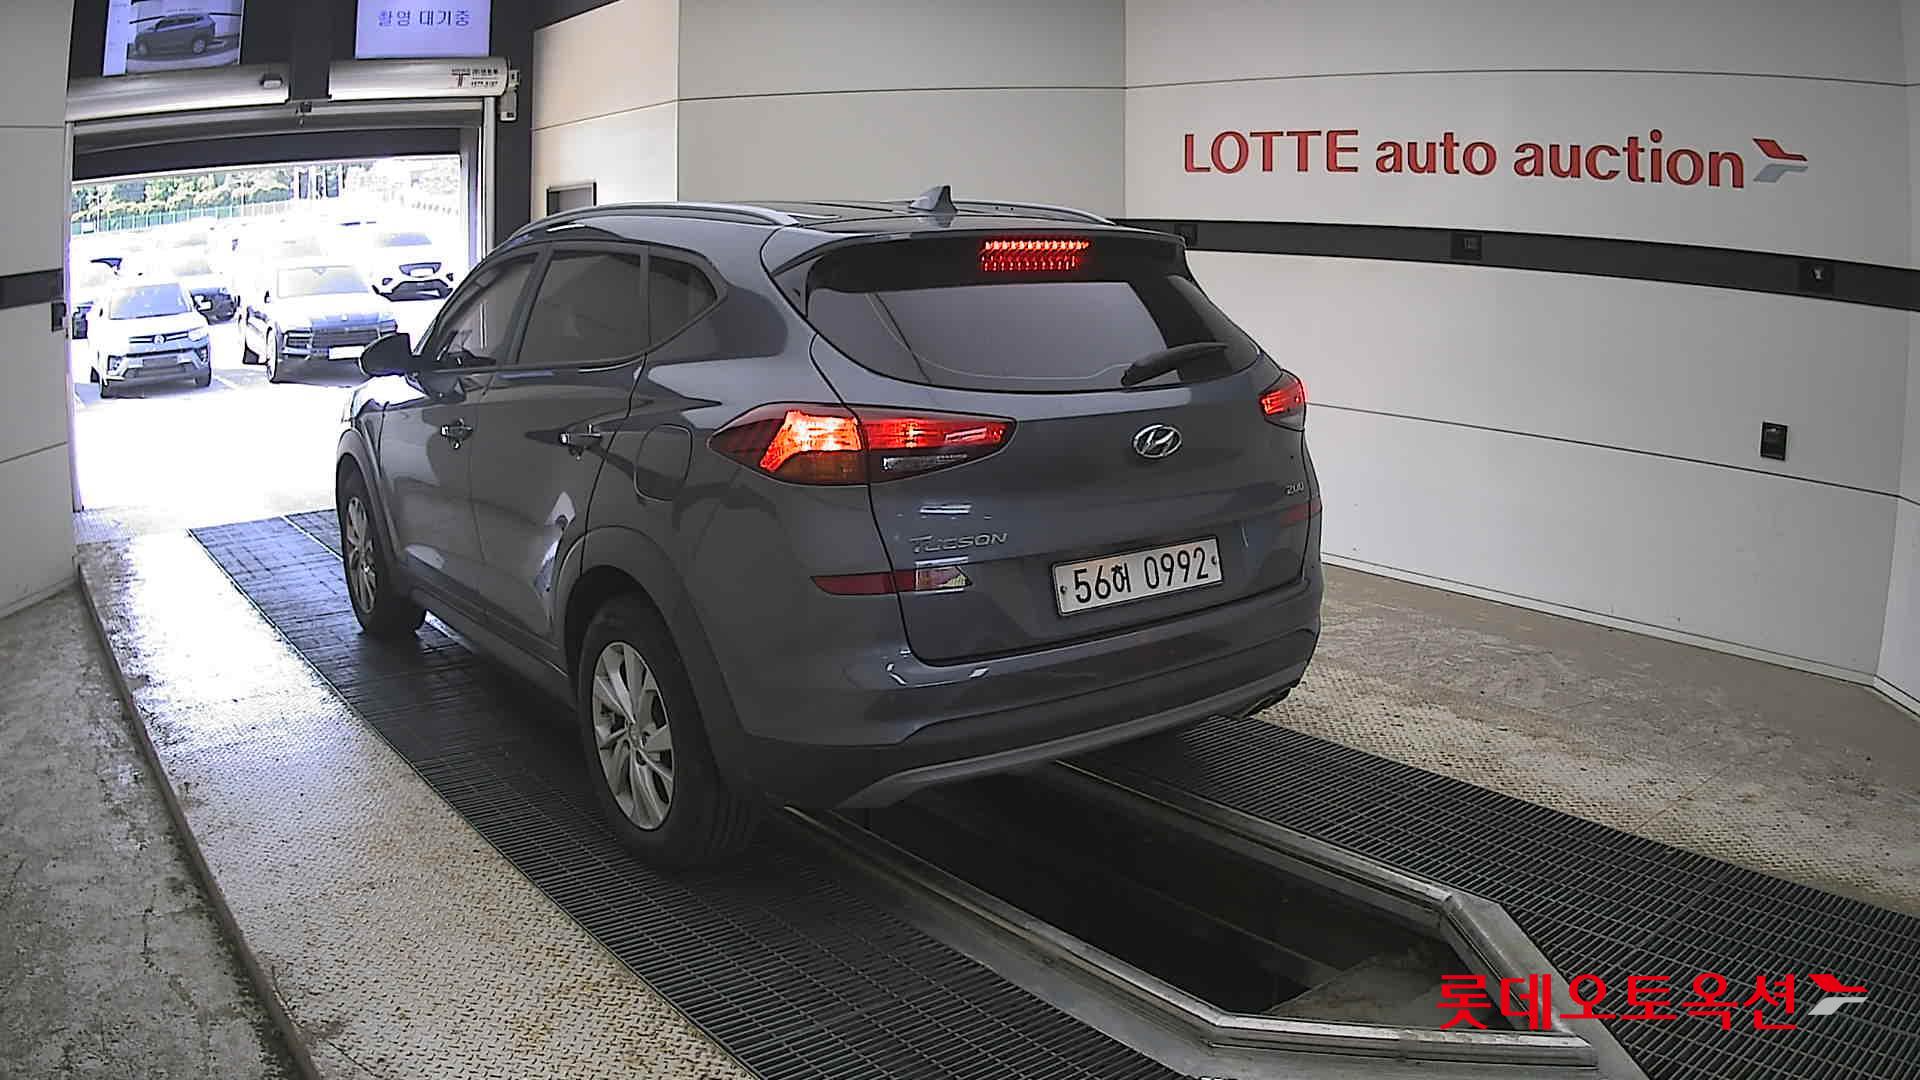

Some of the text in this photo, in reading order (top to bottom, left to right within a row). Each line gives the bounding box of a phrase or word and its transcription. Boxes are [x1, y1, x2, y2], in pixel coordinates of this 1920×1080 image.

[419, 10, 470, 27] 대기중
[1184, 129, 1746, 188] LOTTE auto auction
[1073, 547, 1209, 604] 56허 0992
